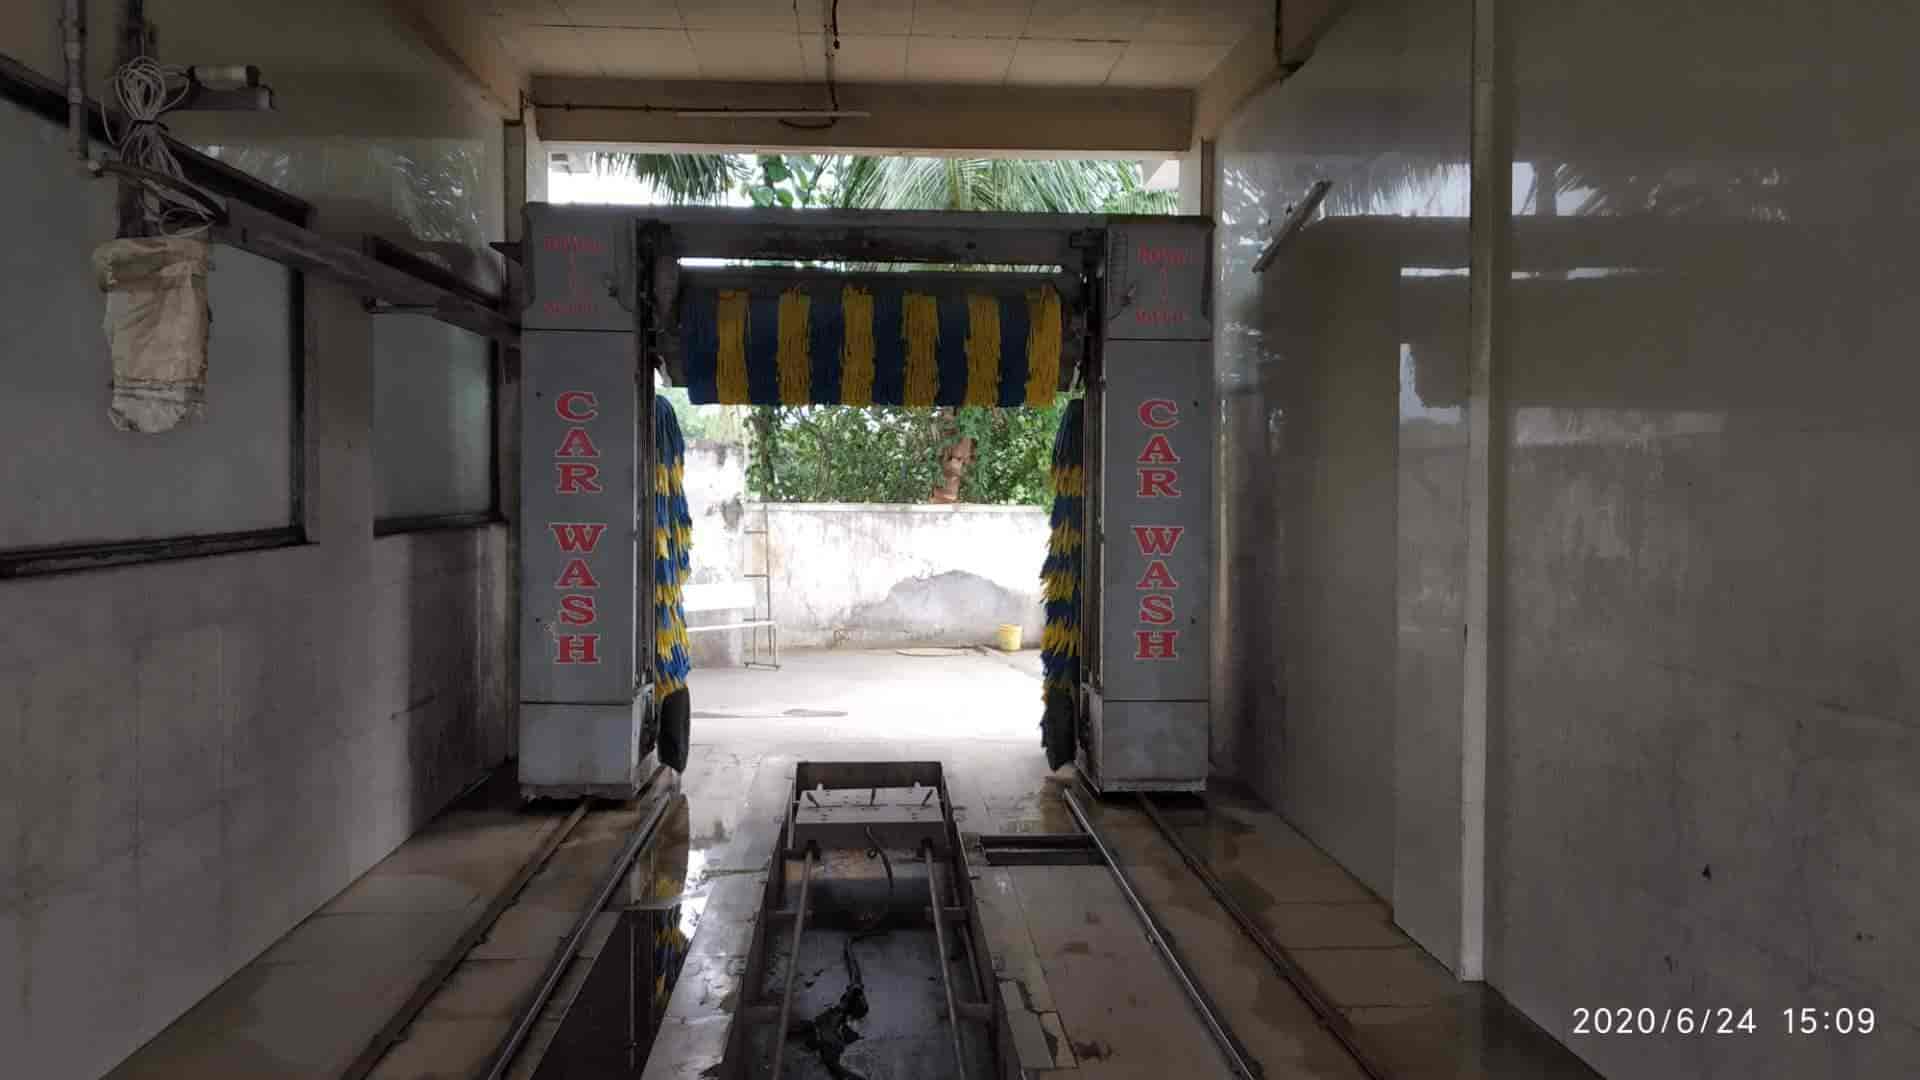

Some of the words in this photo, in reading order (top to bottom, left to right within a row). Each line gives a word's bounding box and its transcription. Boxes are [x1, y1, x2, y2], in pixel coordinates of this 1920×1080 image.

[555, 391, 602, 495] CAR
[1136, 399, 1181, 497] CAR
[551, 522, 608, 665] WASH
[1134, 525, 1184, 660] WASH
